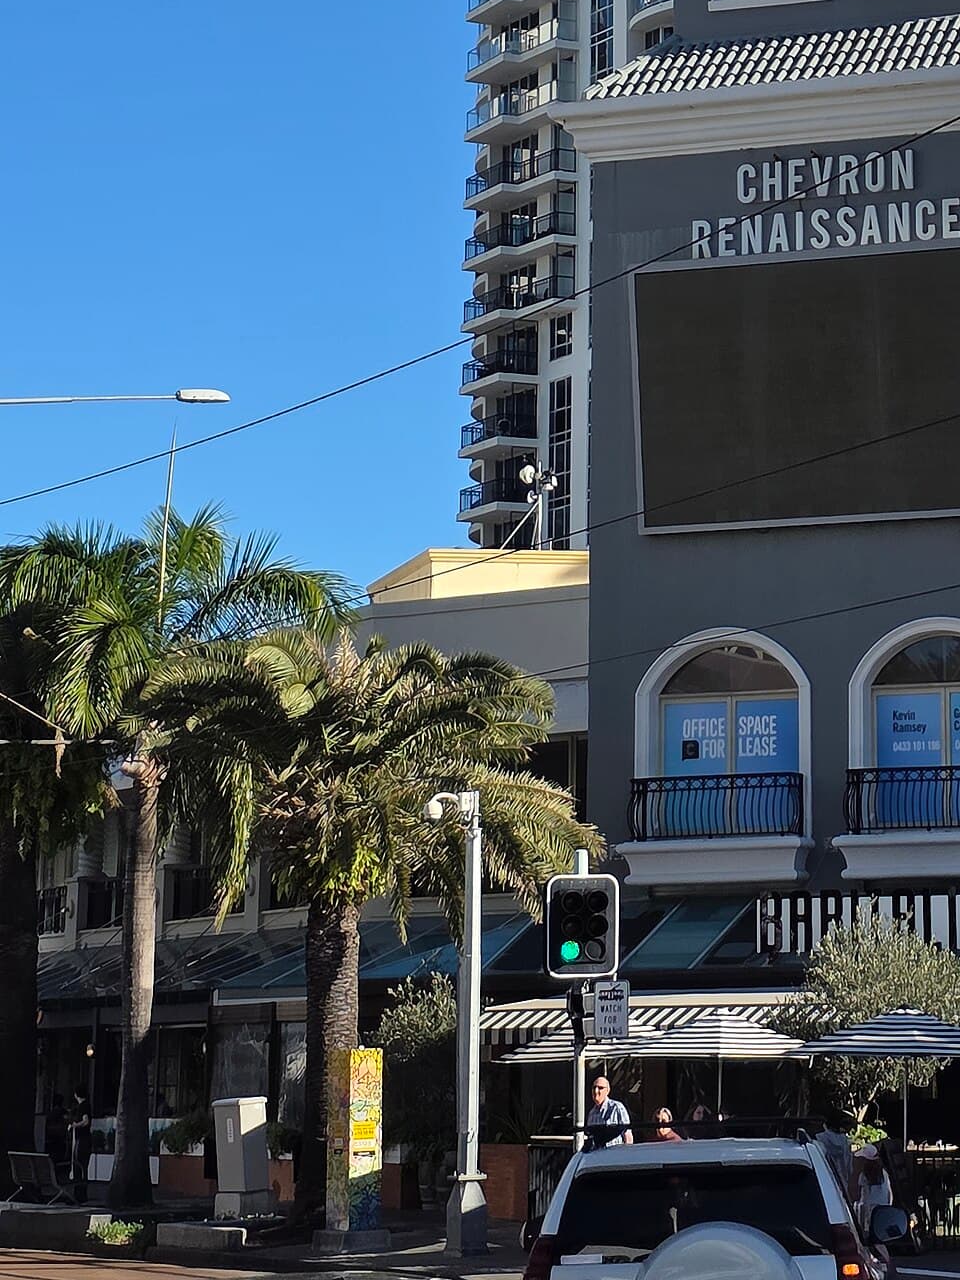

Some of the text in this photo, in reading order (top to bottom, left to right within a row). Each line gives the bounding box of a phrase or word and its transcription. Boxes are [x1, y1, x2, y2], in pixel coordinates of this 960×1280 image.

[735, 149, 915, 204] CHEVRON
[892, 709, 916, 721] Kevin
[682, 715, 777, 739] OFFICE SPACE
[892, 721, 927, 734] Ramsey
[701, 736, 777, 759] FOR LEASE
[600, 1004, 622, 1014] WATCH
[604, 1015, 617, 1025] FOR
